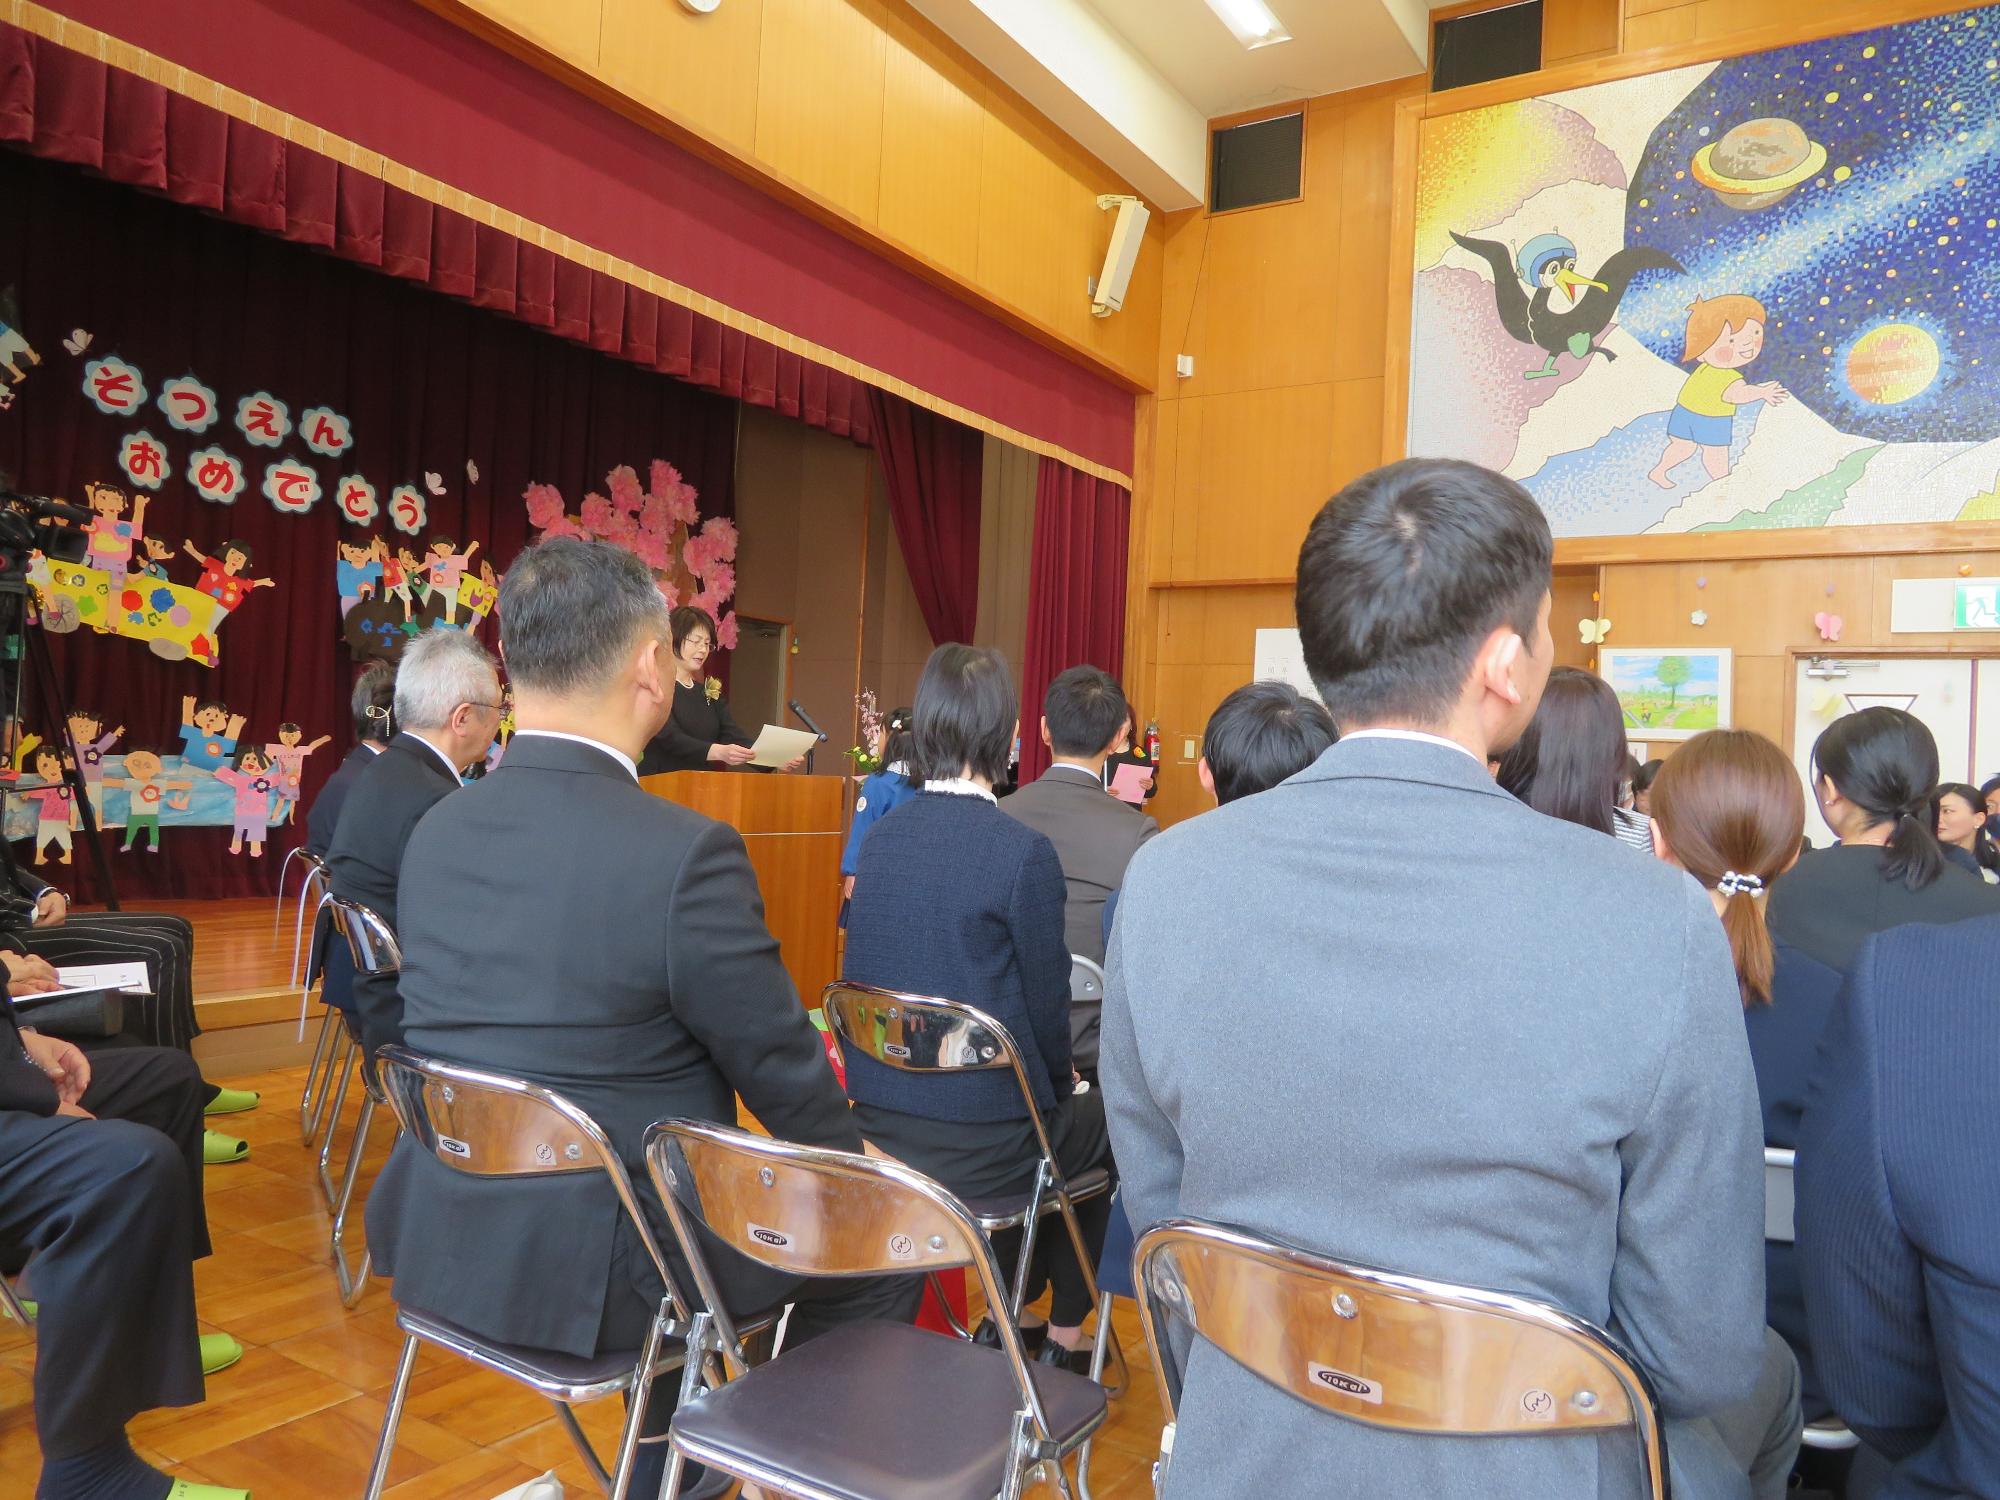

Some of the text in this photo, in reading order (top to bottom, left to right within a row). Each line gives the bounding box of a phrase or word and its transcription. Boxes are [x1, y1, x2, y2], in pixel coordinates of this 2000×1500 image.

[94, 366, 343, 447] そつえん
[129, 441, 420, 527] おめでとう
